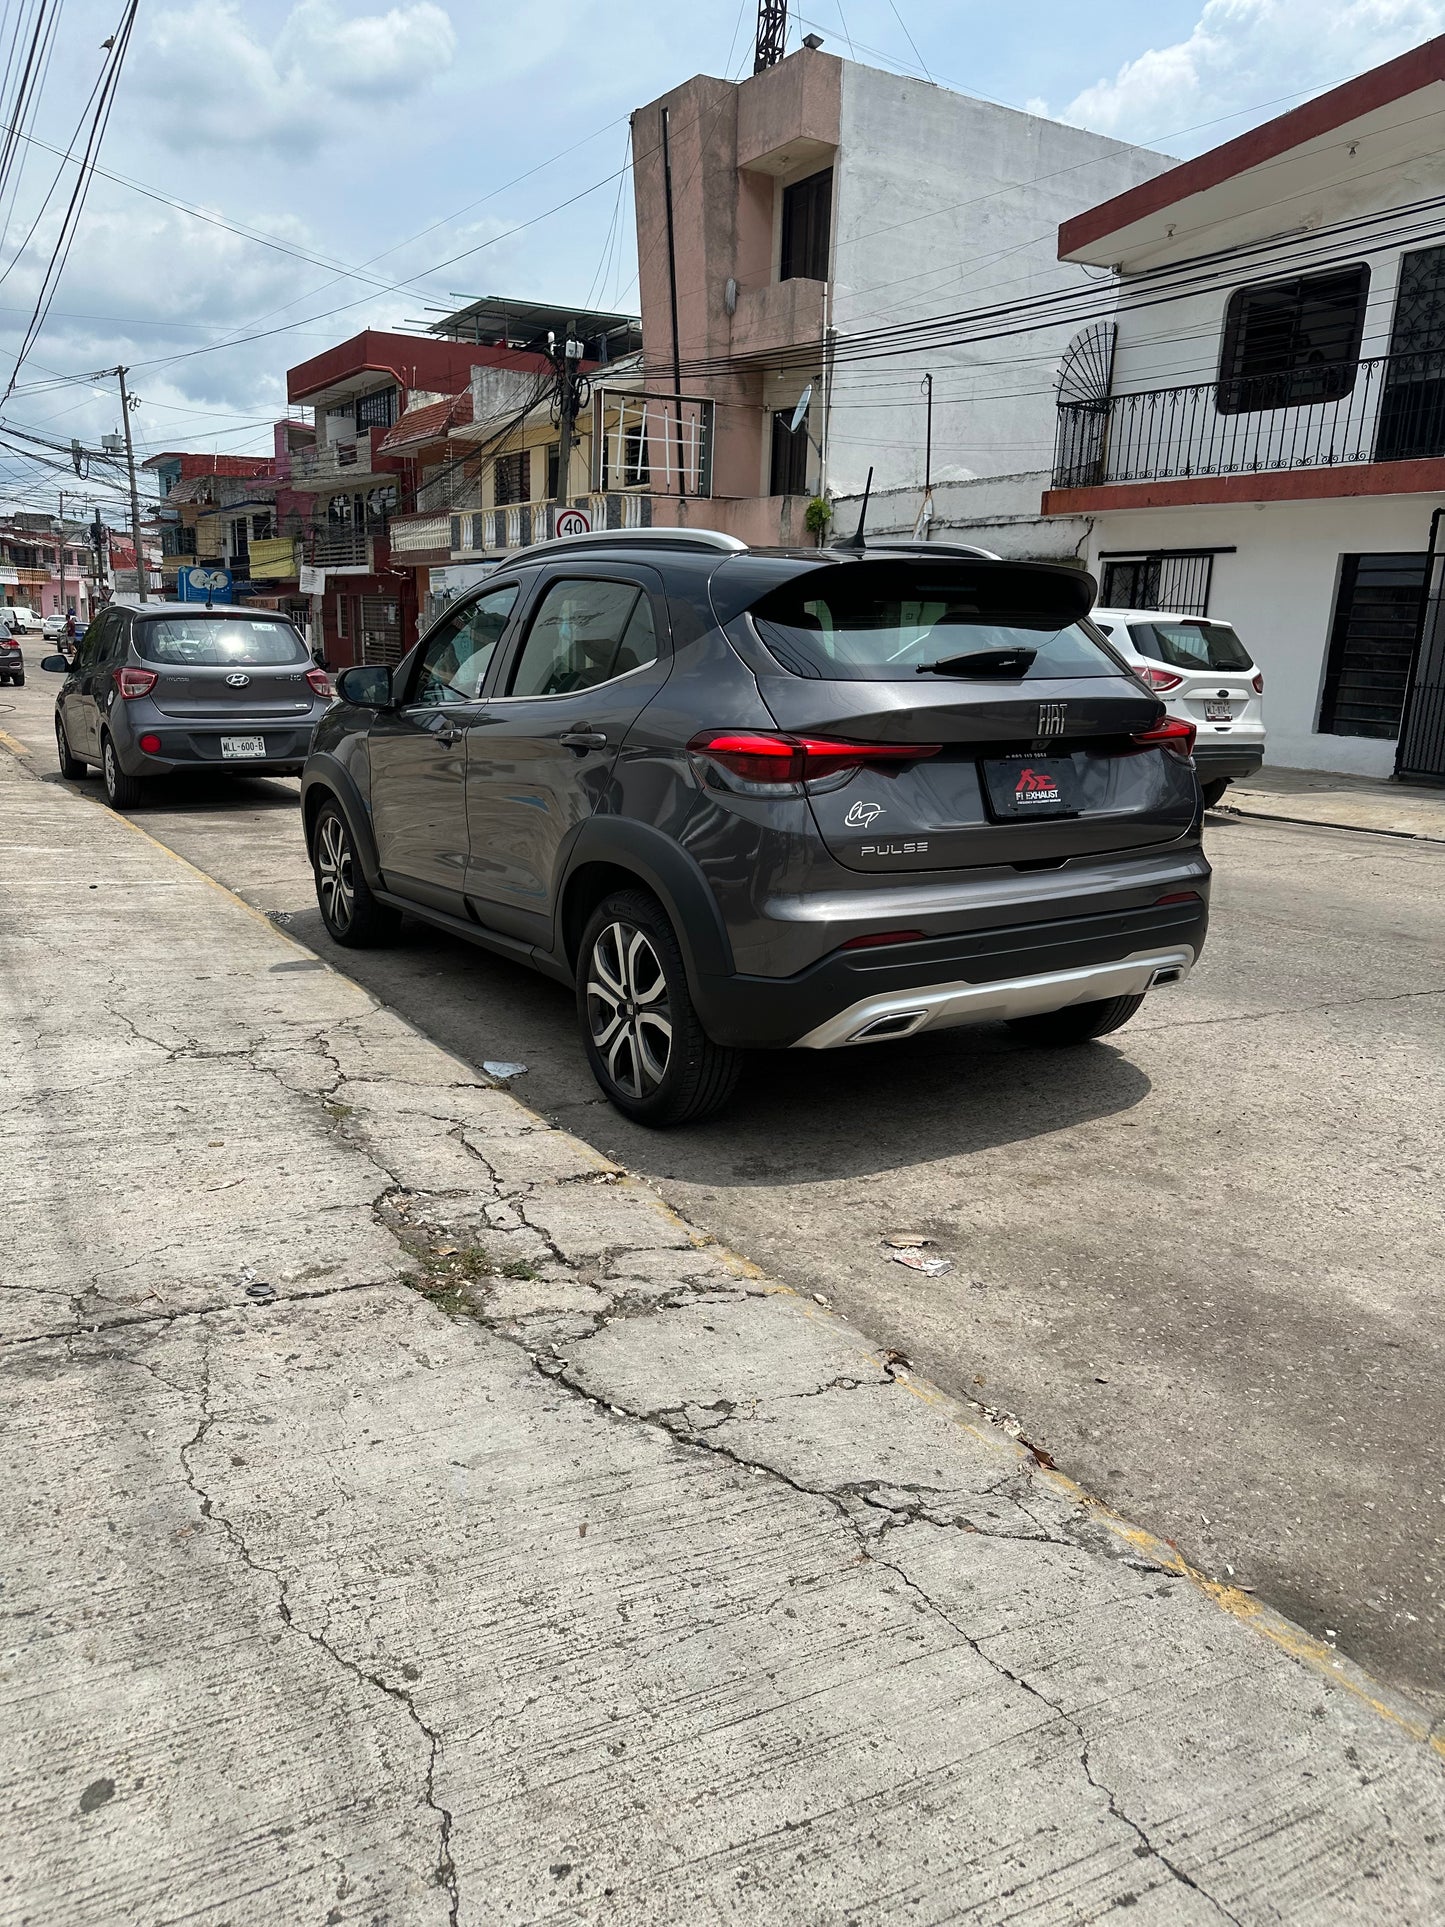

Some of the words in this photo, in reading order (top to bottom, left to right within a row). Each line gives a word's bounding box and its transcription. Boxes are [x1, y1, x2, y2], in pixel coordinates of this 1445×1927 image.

[564, 518, 583, 535] 40
[1037, 703, 1068, 735] FIAT
[1025, 789, 1059, 800] EXHAUST
[860, 841, 929, 857] PULSE
